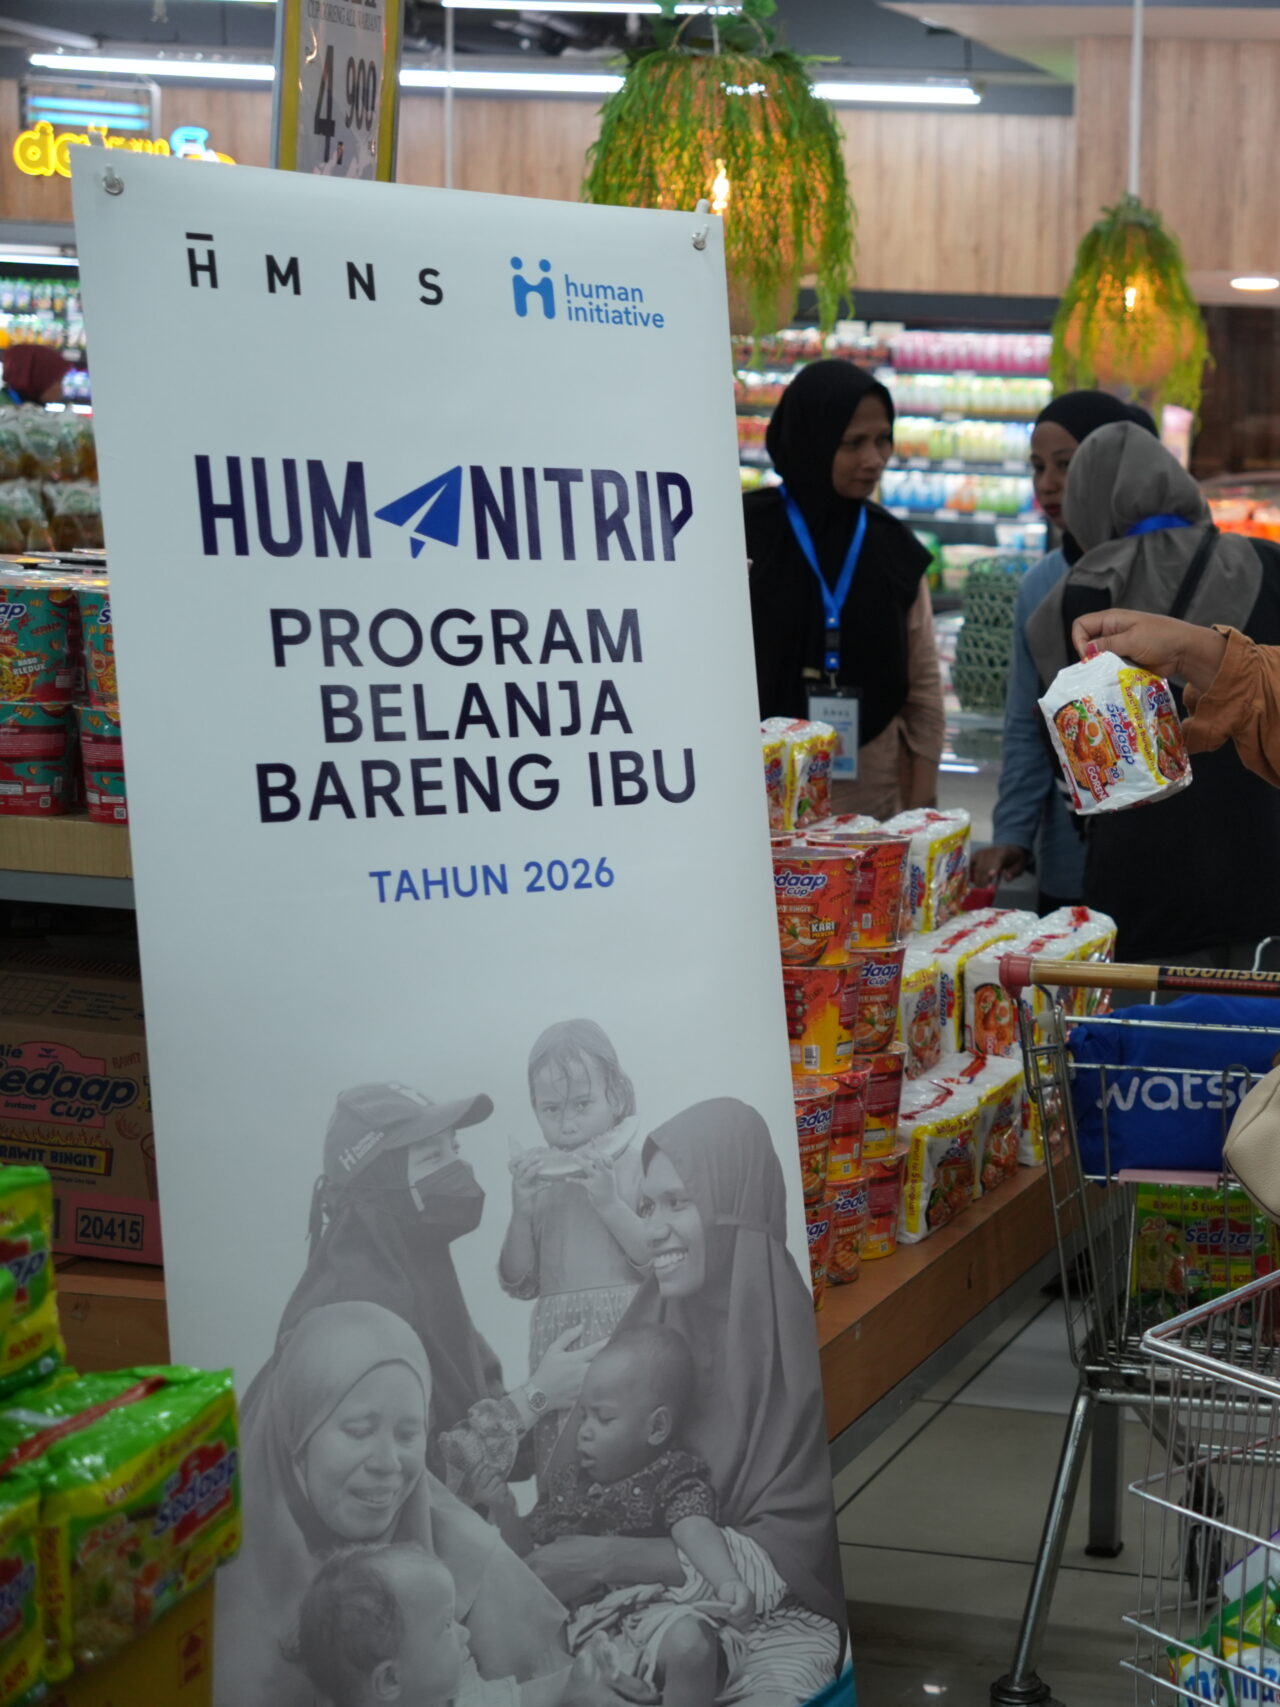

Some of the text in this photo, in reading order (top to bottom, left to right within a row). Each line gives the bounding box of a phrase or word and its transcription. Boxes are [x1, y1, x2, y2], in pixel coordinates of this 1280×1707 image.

[345, 56, 377, 132] 900
[565, 274, 643, 303] human
[567, 301, 665, 329] initiative
[269, 609, 643, 668] PROGRAM
[320, 680, 633, 744] BELANJA
[1106, 703, 1135, 766] Sedaap
[255, 748, 697, 824] BARENG IBU
[368, 857, 616, 904] TAHUN 2026
[774, 871, 826, 890] daap
[811, 922, 835, 933] KARI
[0, 1062, 138, 1114] edaap
[1095, 1072, 1258, 1112] wats
[50, 1100, 97, 1123] Cup
[51, 1150, 97, 1169] BINGIT
[79, 1214, 142, 1245] 20415
